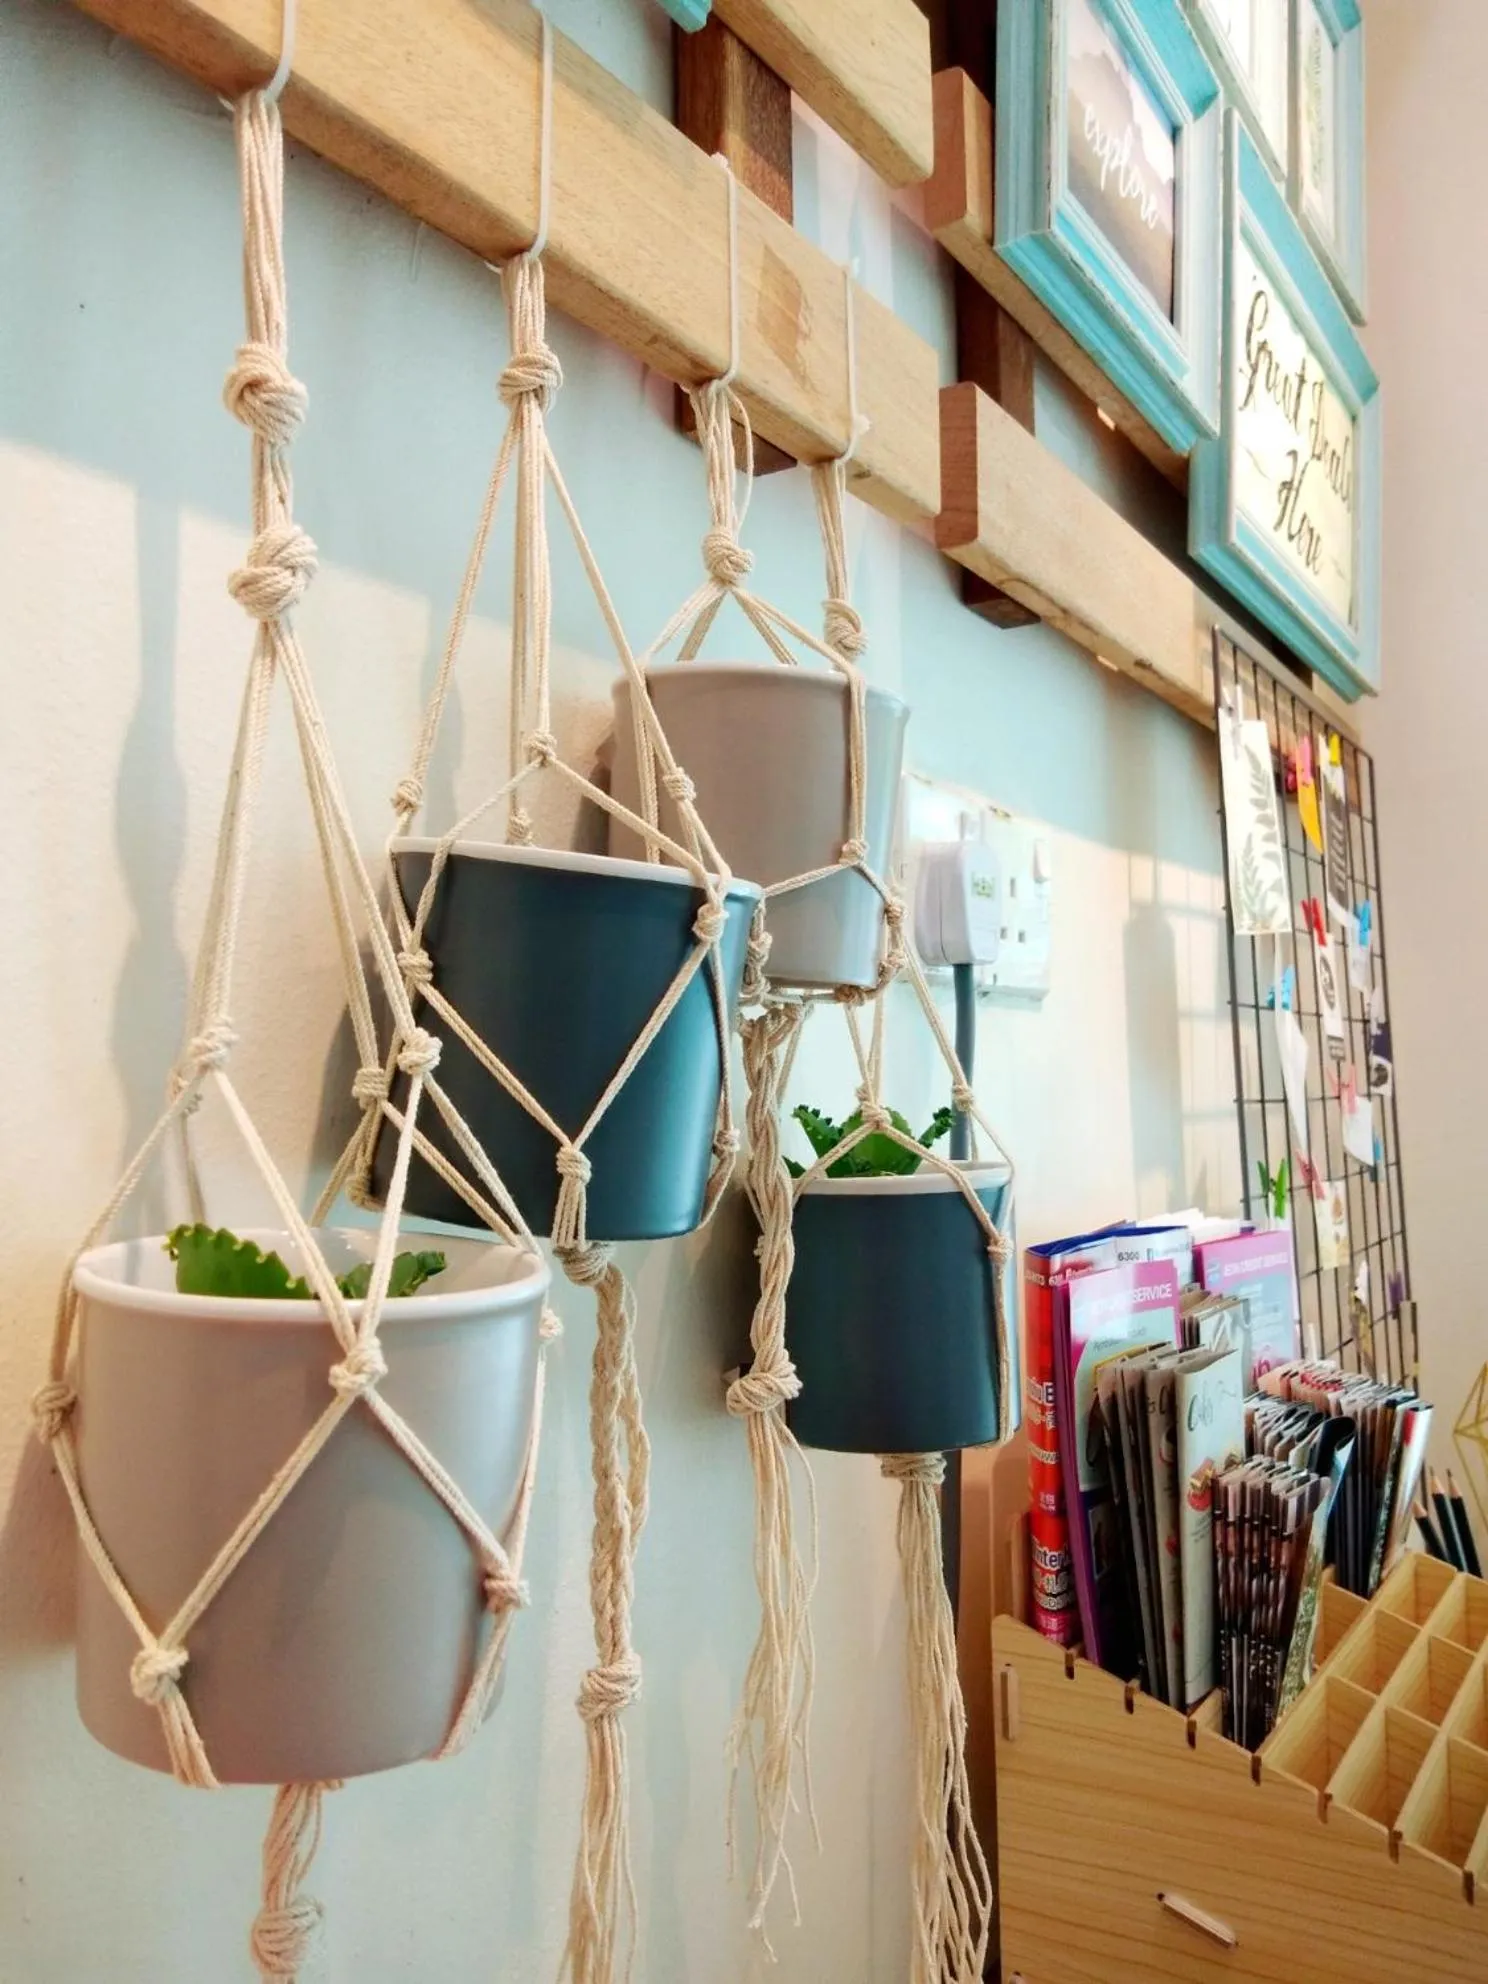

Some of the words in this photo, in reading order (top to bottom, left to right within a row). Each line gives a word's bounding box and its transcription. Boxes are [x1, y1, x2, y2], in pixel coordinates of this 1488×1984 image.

[1083, 102, 1160, 230] explore
[1238, 289, 1307, 435] Great
[1273, 448, 1323, 576] Here
[1132, 1283, 1173, 1303] SERVICE
